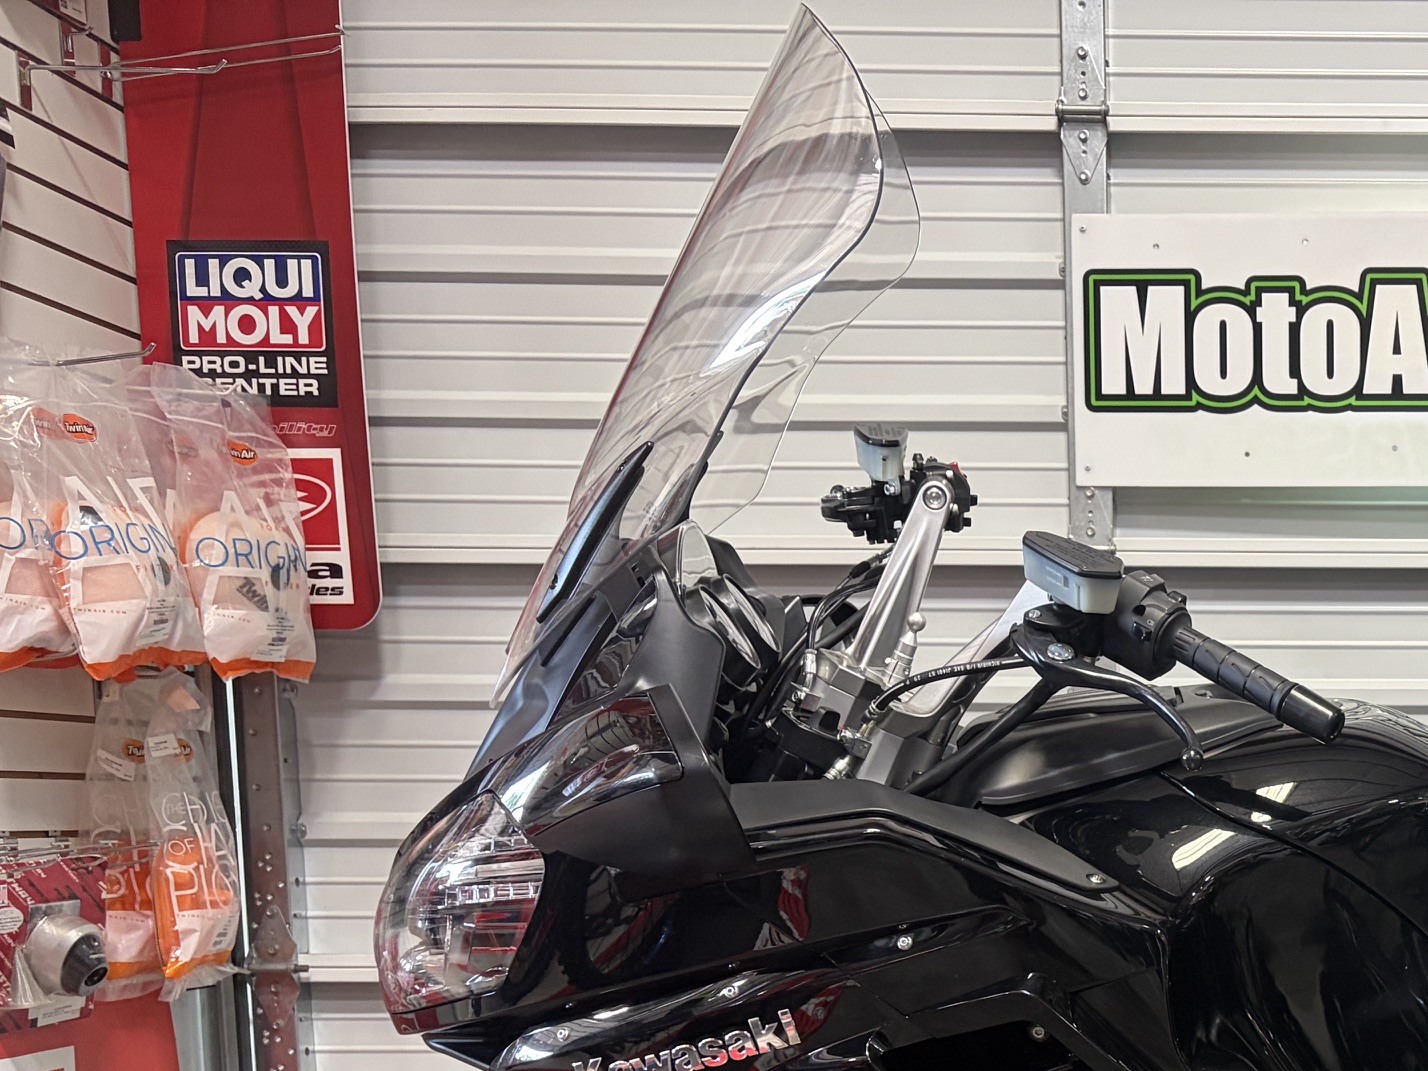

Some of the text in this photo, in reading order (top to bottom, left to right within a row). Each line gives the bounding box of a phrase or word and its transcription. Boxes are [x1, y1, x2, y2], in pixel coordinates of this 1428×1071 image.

[184, 257, 314, 300] LIQUI
[186, 304, 320, 345] MOLY
[181, 355, 328, 374] PRO-LINE
[168, 838, 195, 856] OF
